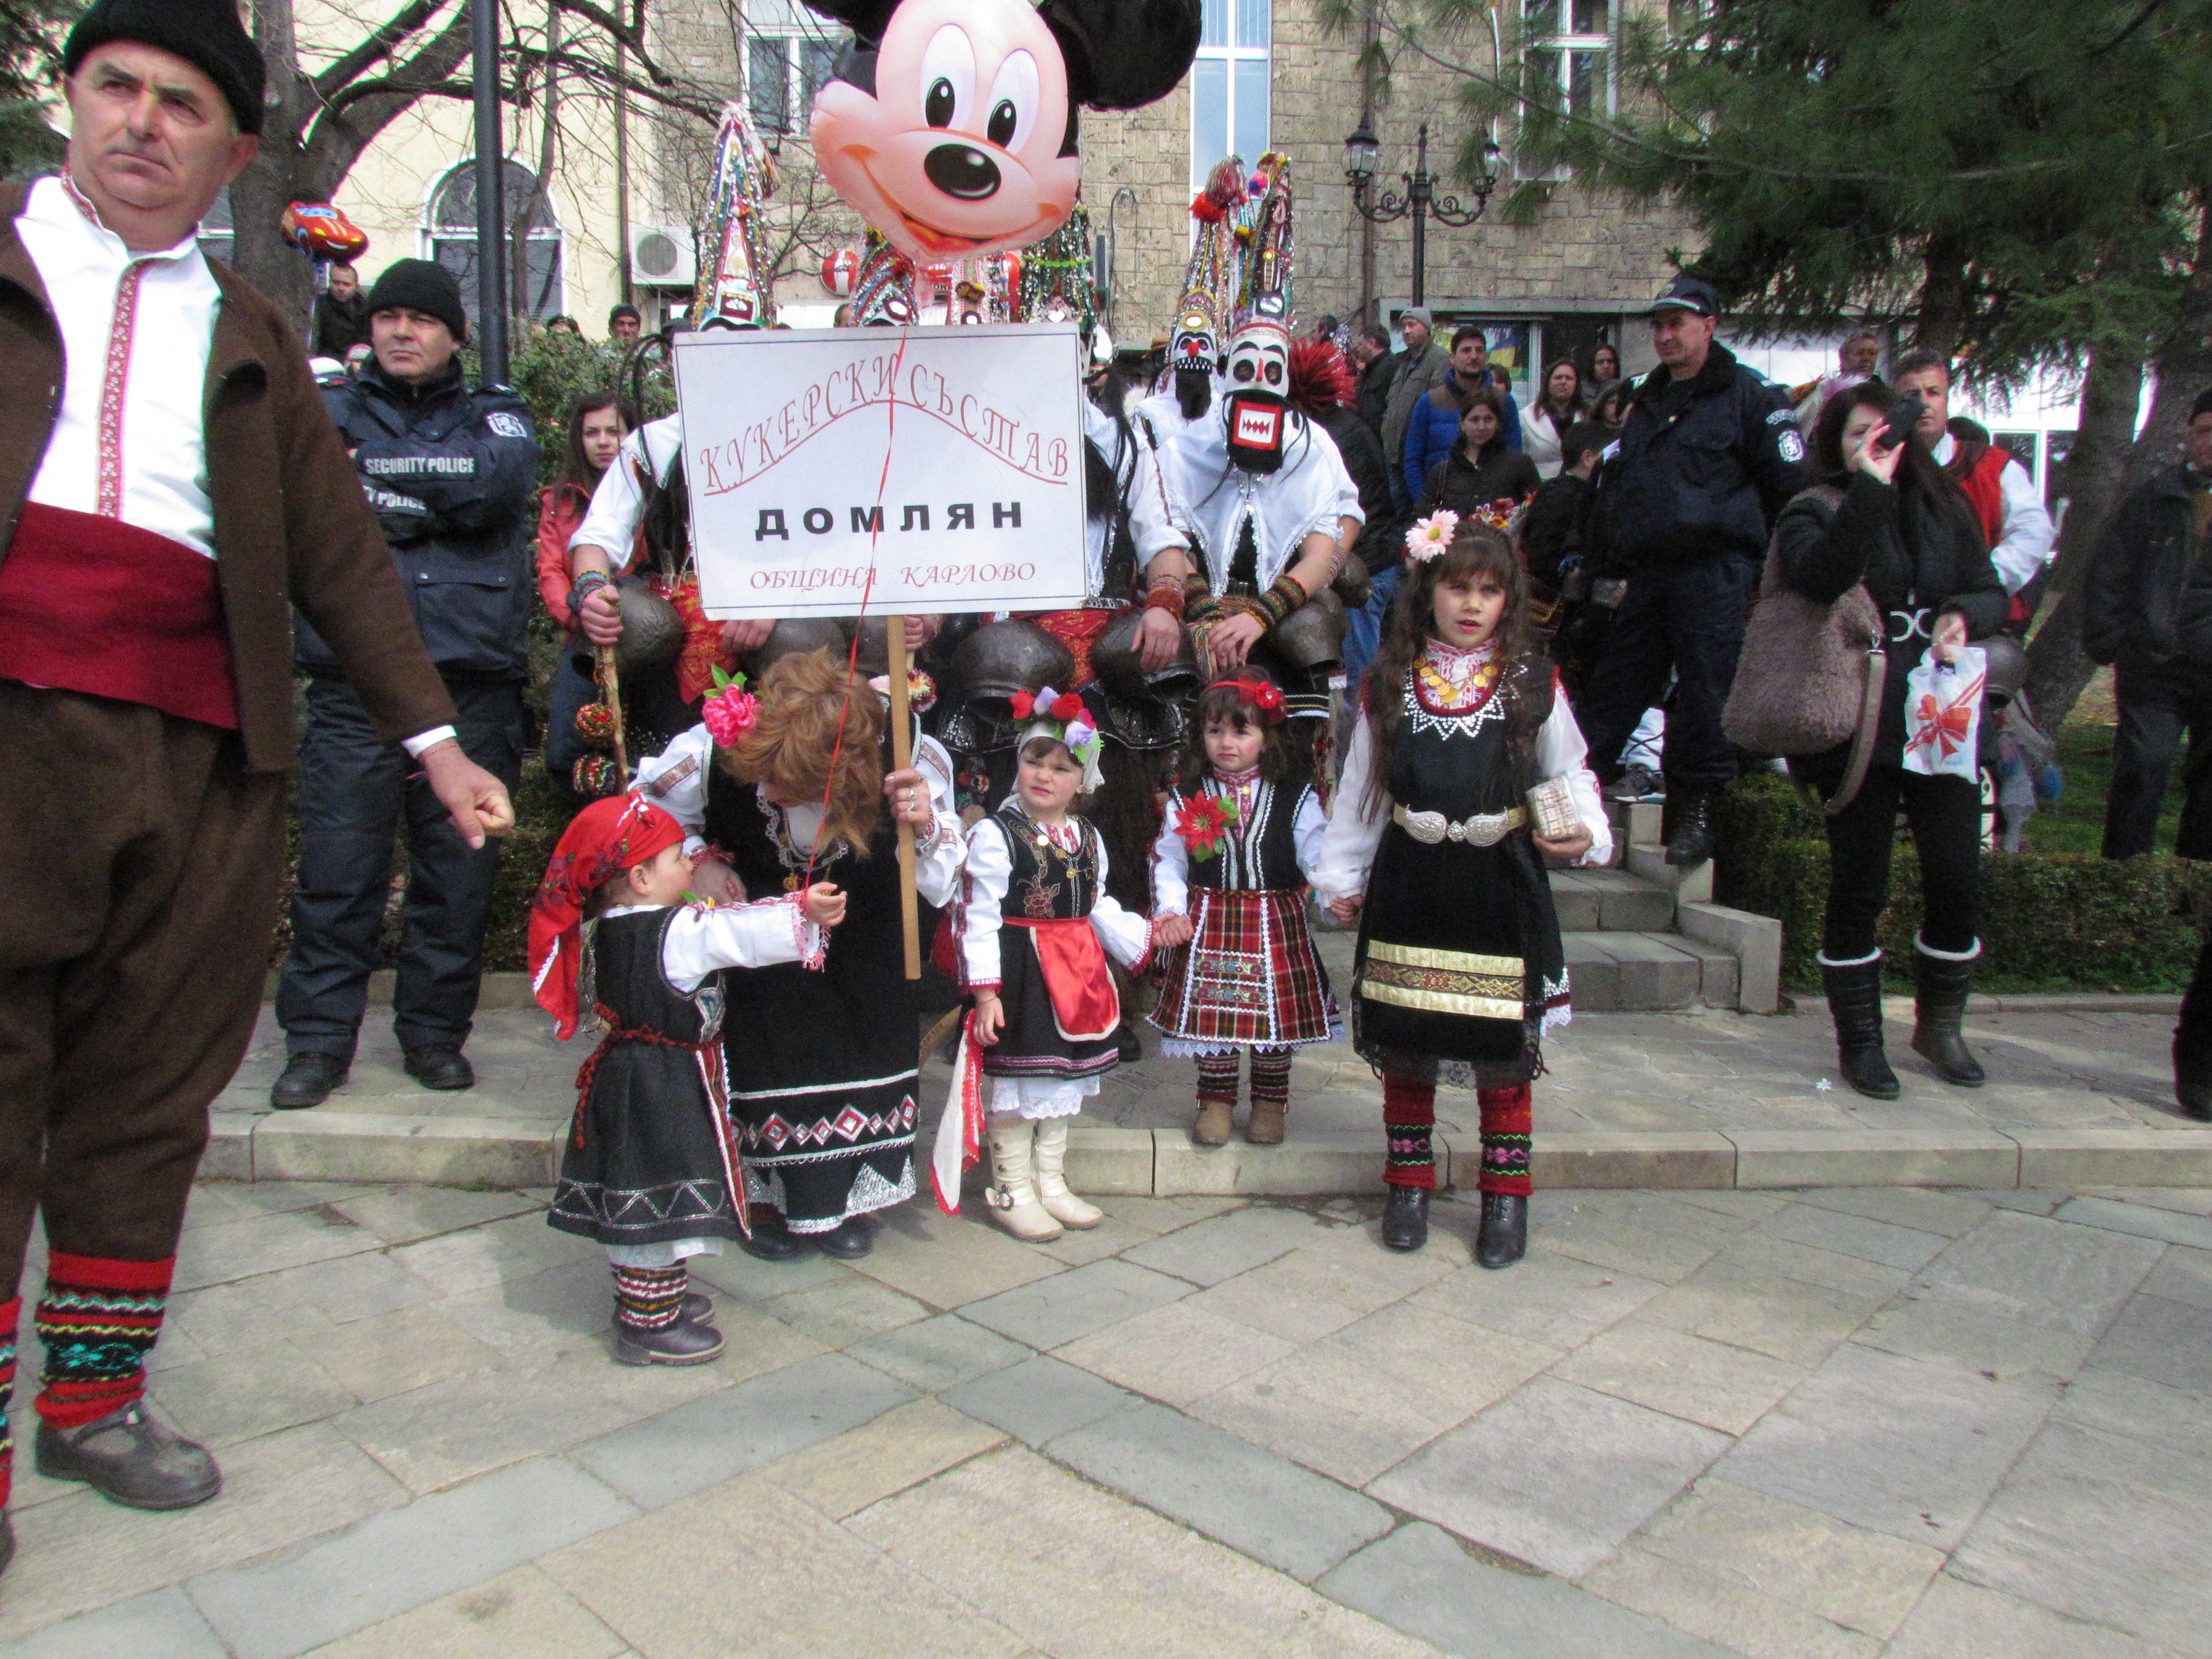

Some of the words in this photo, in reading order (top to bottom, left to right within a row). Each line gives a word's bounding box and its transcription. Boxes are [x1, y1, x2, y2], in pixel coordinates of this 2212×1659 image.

[700, 353, 900, 493] КУКЕРСКИ
[910, 364, 1068, 476] СЪСТАВ
[365, 457, 426, 475] SECURITY
[427, 456, 475, 474] POLICE
[377, 492, 427, 511] POLICE
[755, 501, 1022, 541] ДОМЛЯН
[750, 567, 879, 592] ОБЩИНА
[901, 562, 1036, 588] КАРЛОВО
